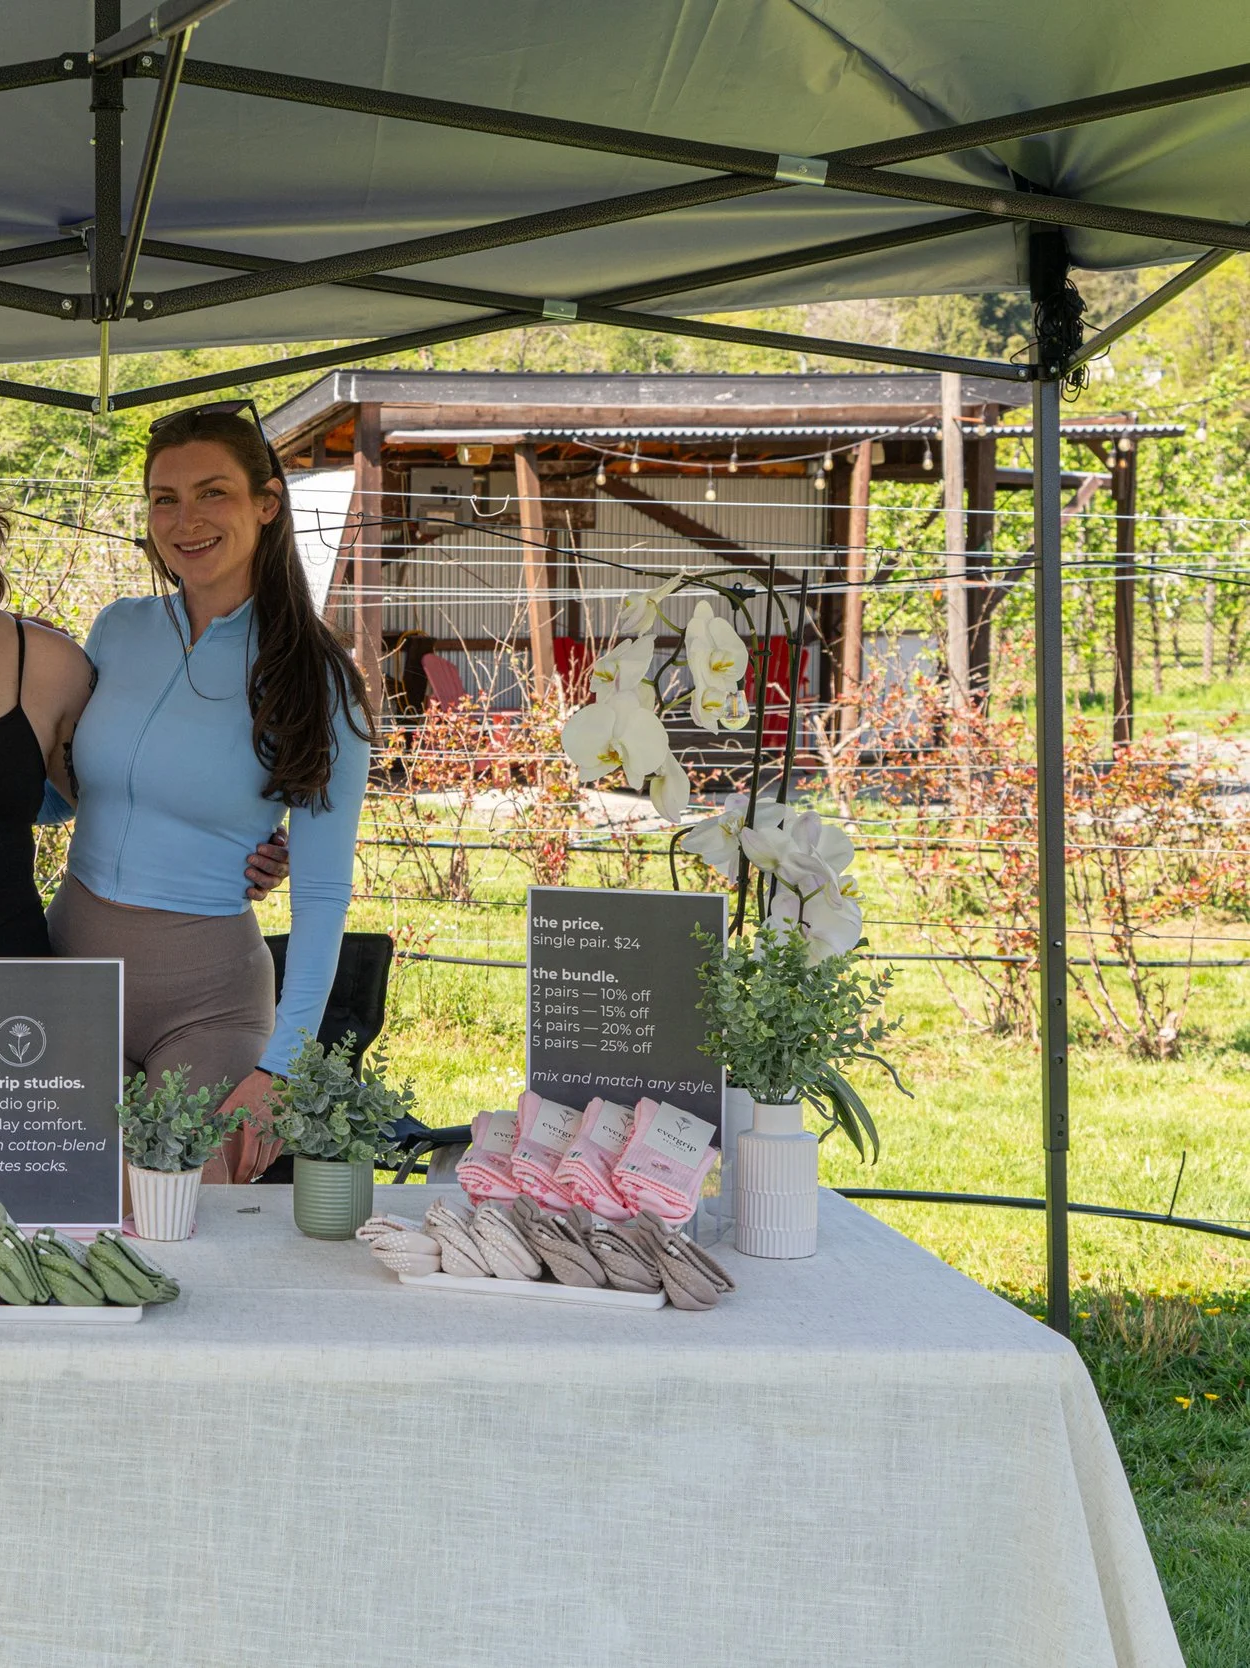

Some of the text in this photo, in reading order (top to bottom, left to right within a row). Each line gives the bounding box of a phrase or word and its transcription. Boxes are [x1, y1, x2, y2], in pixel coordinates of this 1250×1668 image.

[533, 916, 603, 931] the price.
[533, 933, 640, 950] single pair. $24
[533, 967, 618, 983] the bundle.
[533, 985, 540, 995] 2
[545, 986, 579, 998] pairs
[601, 988, 627, 1000] 10%
[632, 990, 651, 1001] off
[533, 1001, 540, 1012] 3
[545, 1003, 578, 1015] pairs
[600, 1005, 625, 1017] 15%
[630, 1007, 649, 1019] off
[533, 1019, 542, 1029] 4
[546, 1020, 580, 1033] pairs
[602, 1023, 631, 1035] 20%
[636, 1025, 655, 1036] off
[533, 1035, 540, 1046] 5
[545, 1037, 578, 1049] pairs
[601, 1040, 628, 1052] 25%
[633, 1042, 652, 1053] off
[24, 1076, 84, 1088] studios.
[533, 1070, 715, 1094] mix and match any style.
[27, 1098, 60, 1112] grip.
[24, 1118, 86, 1130] comfort.
[8, 1139, 106, 1151] cotton-blend
[25, 1160, 67, 1171] socks.
